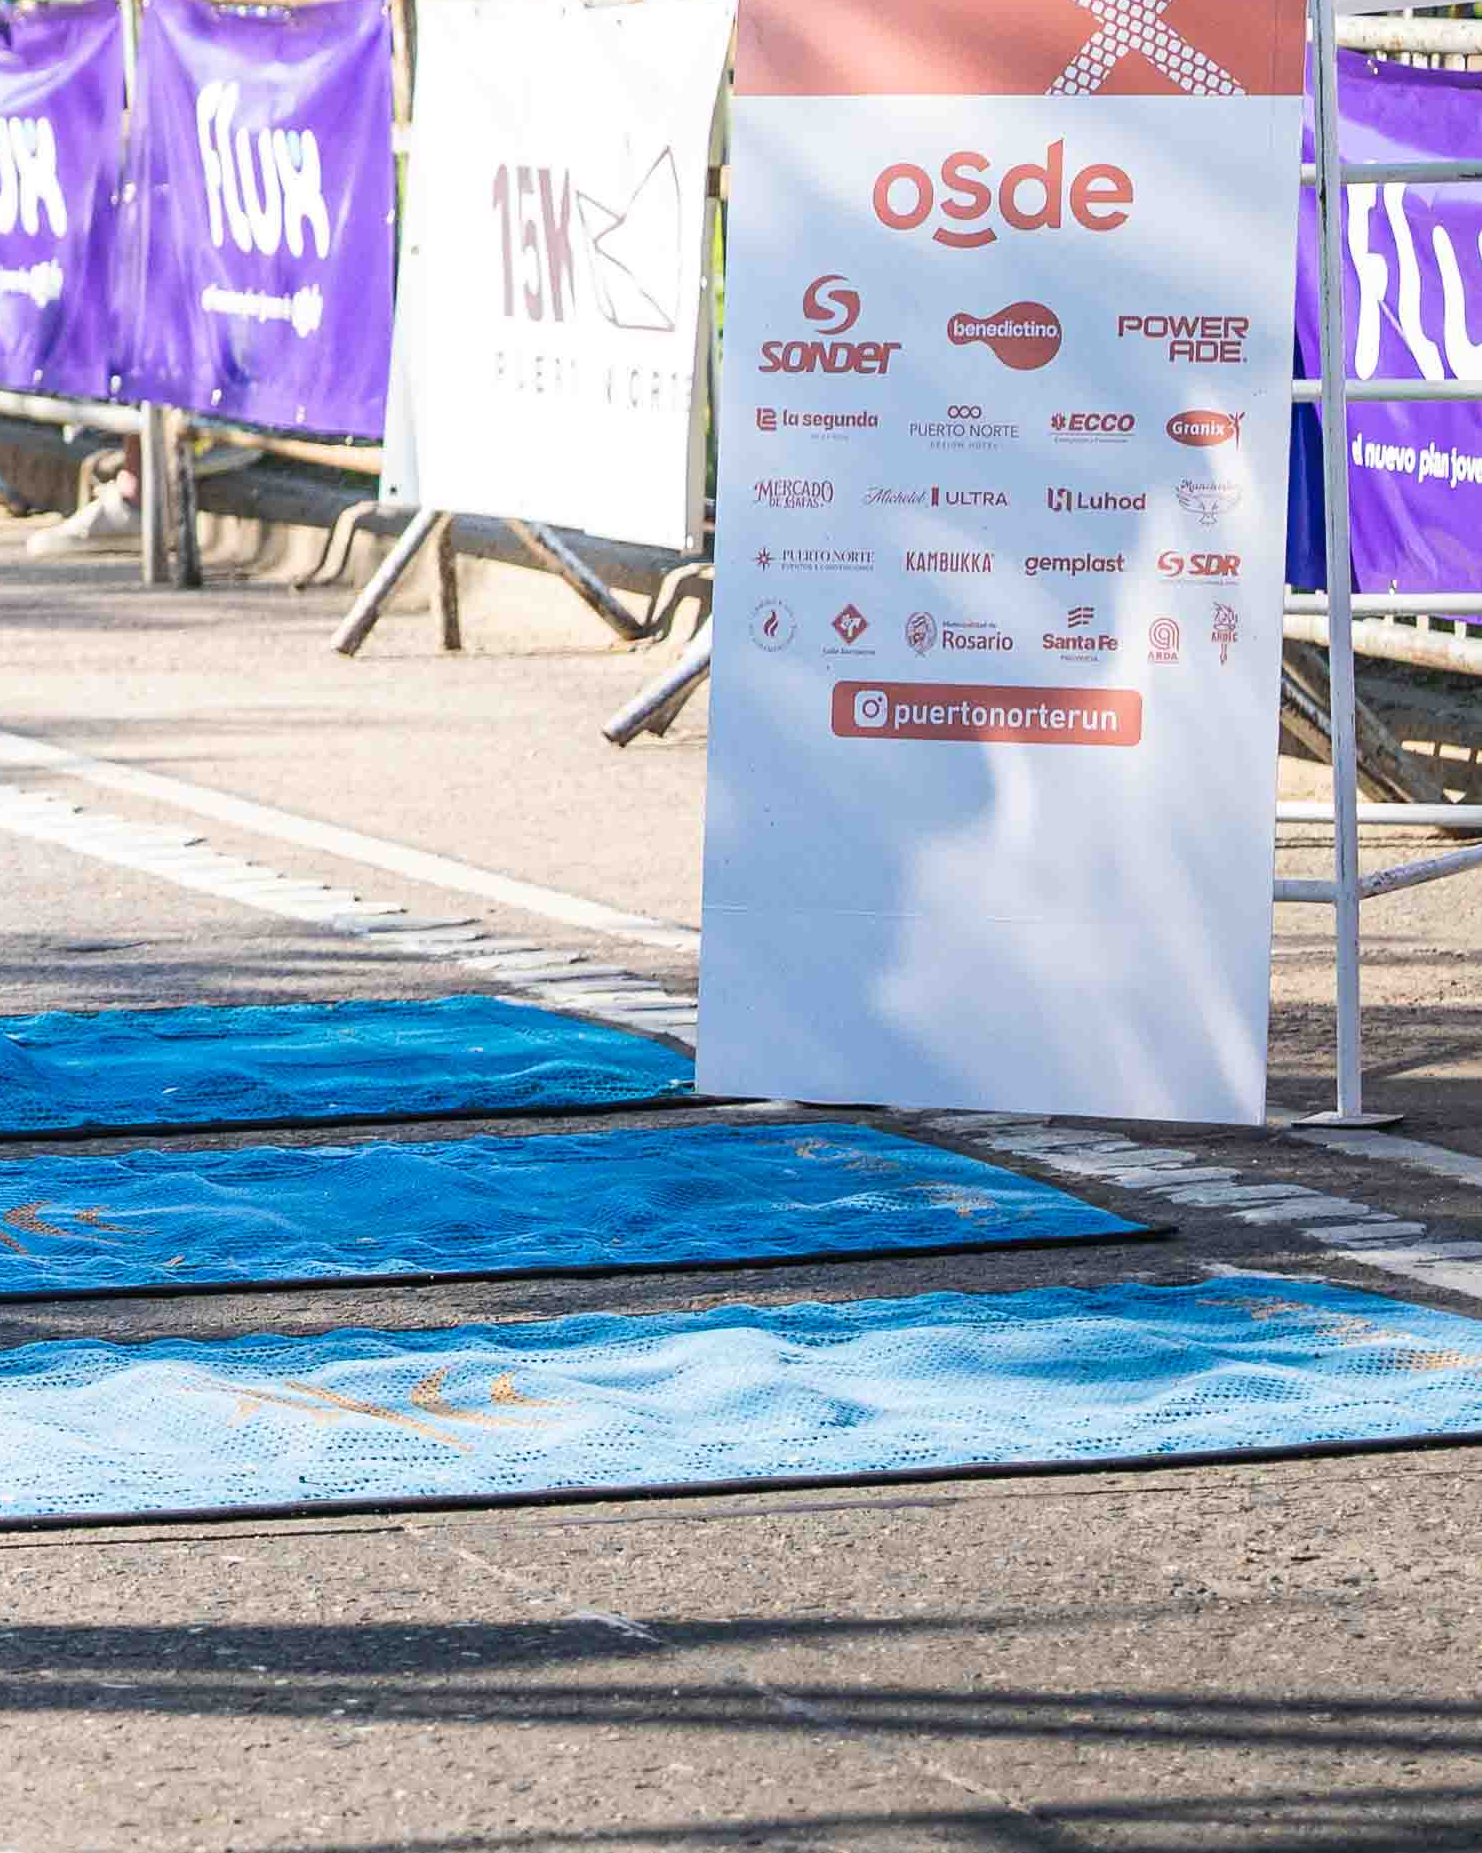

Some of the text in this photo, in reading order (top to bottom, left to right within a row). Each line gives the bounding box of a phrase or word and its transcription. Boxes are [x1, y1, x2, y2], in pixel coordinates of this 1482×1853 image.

[872, 138, 1135, 250] osde
[492, 162, 577, 323] 15K
[1117, 315, 1250, 339] POWER
[783, 409, 879, 431] la segunda
[909, 422, 1020, 439] PUERTO NORTE
[1068, 413, 1136, 432] ECCO
[1365, 442, 1416, 474] nuevo
[754, 479, 834, 504] MERCADO
[945, 490, 1009, 506] ULTRA
[1077, 491, 1147, 511] Luhod
[906, 551, 992, 573] KAMBUKKA
[1025, 553, 1125, 577] gemplast
[1188, 553, 1241, 576] SDR
[942, 629, 1015, 653] Rosario
[1042, 633, 1119, 652] Santa Fe
[893, 699, 1121, 733] puertonorterun
